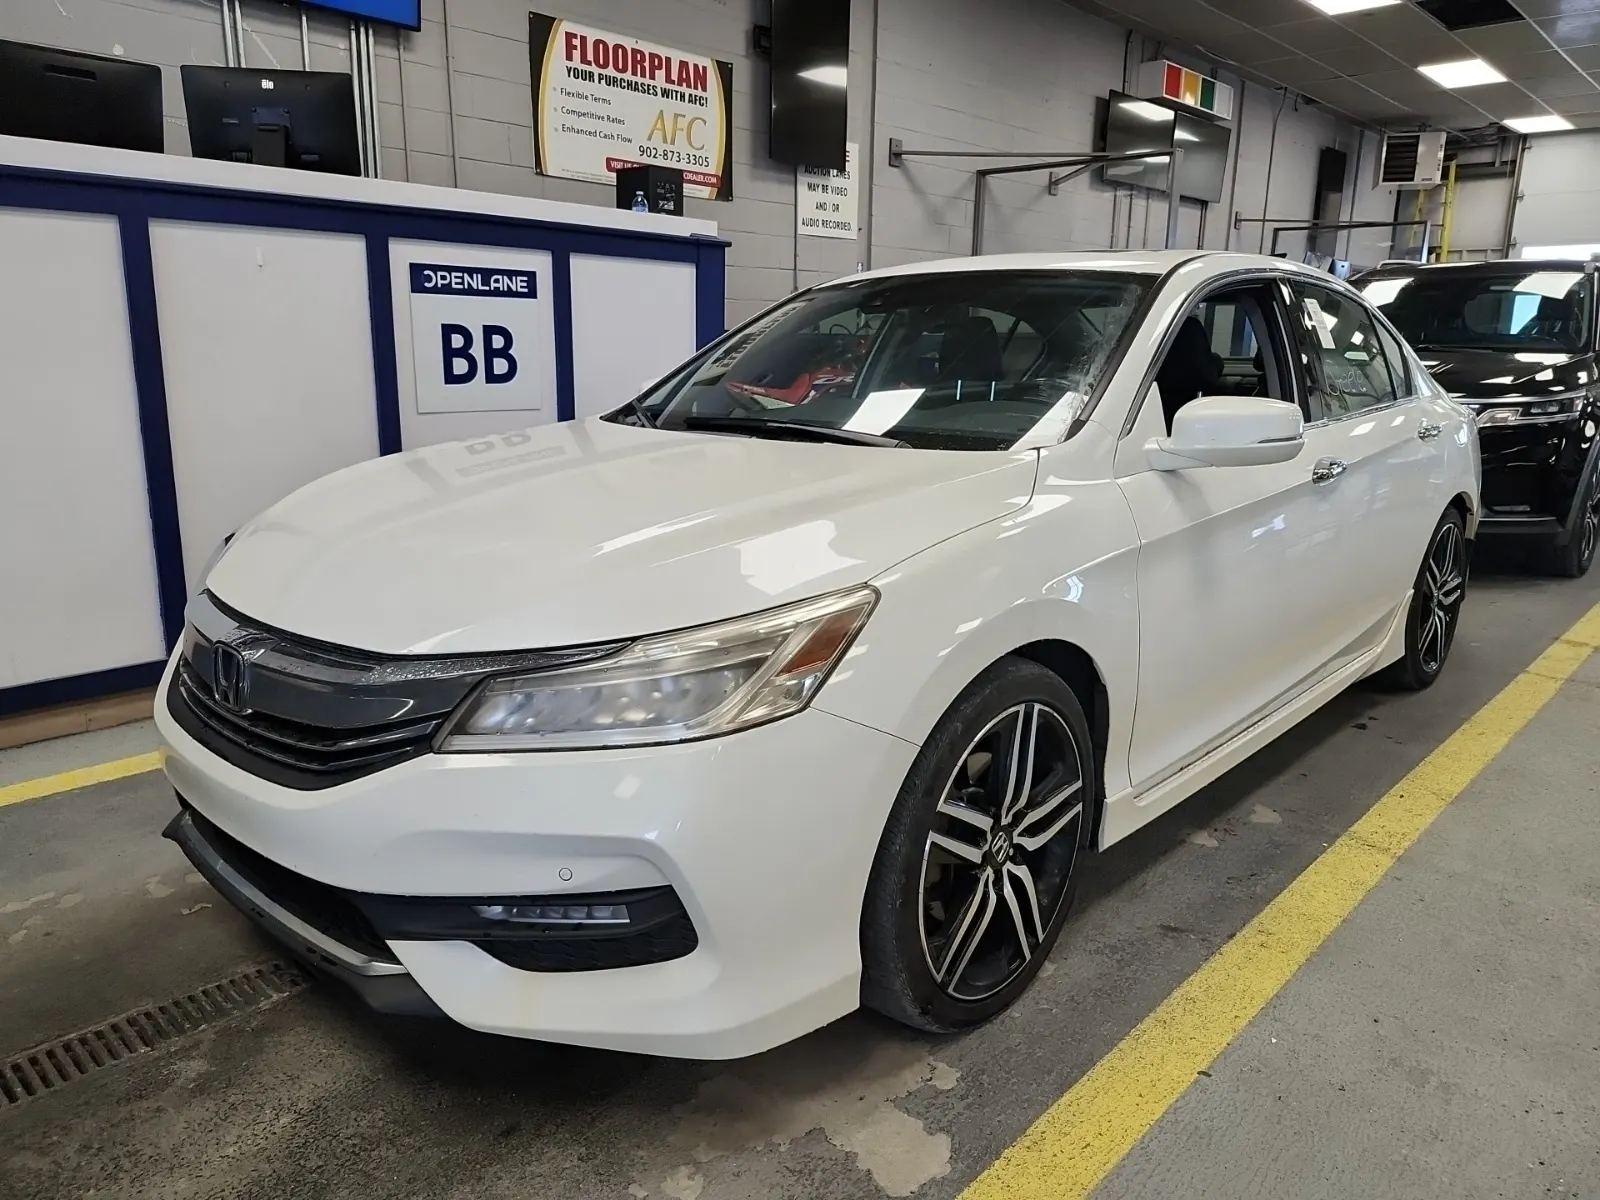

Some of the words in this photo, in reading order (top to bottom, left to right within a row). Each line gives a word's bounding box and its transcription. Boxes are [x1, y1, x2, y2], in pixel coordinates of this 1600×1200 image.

[564, 31, 708, 93] FLOORPLAN
[560, 87, 589, 102] Flexible
[590, 94, 612, 106] Terms
[565, 65, 596, 84] YOUR
[597, 73, 659, 98] PURCHASES
[660, 86, 686, 103] WITH
[687, 94, 709, 108] AFC!
[560, 105, 606, 122] Competitive
[606, 114, 626, 126] Rates
[561, 123, 598, 139] Enhanced
[598, 130, 616, 142] Cash
[616, 133, 633, 144] Flow
[646, 109, 708, 152] AFC
[610, 160, 624, 170] VISIT
[638, 144, 710, 168] 902-873-3305
[807, 182, 820, 193] MAY
[821, 184, 829, 194] BE
[830, 186, 848, 197] VIDEO
[801, 217, 820, 228] AUDIO
[821, 219, 852, 232] RECORDED.
[422, 269, 529, 293] OPENLANE
[440, 322, 519, 386] BB
